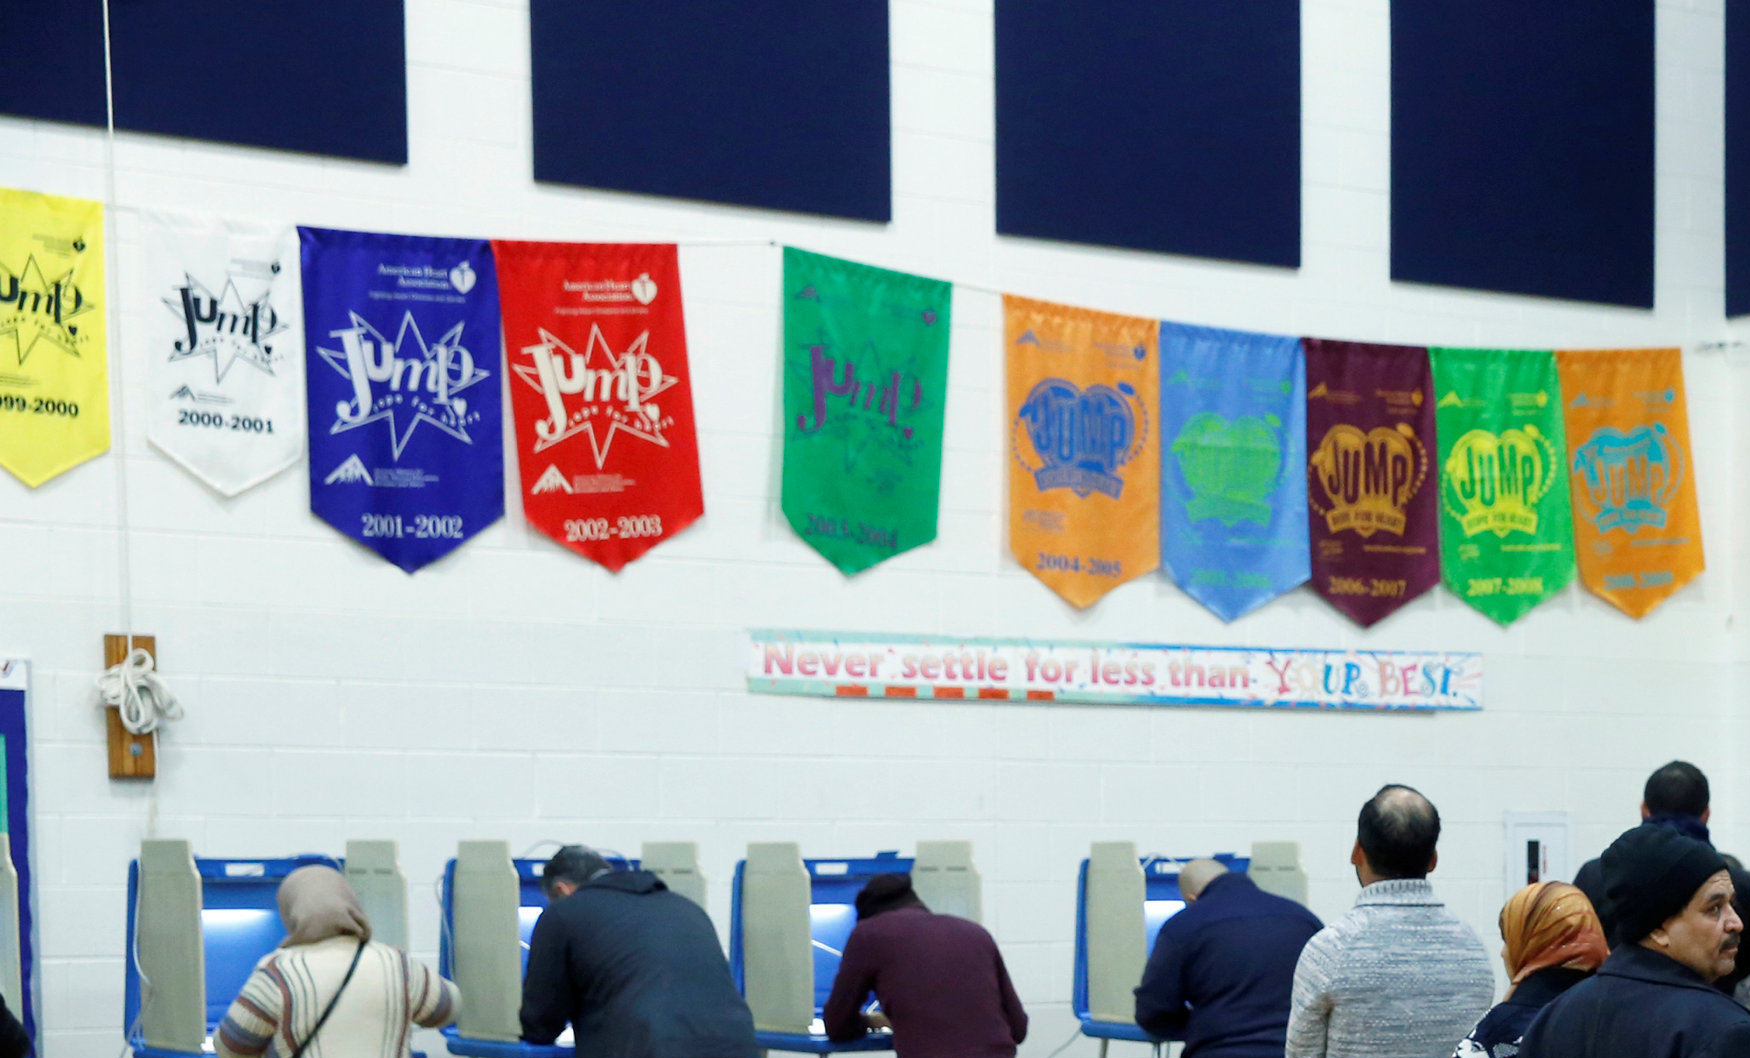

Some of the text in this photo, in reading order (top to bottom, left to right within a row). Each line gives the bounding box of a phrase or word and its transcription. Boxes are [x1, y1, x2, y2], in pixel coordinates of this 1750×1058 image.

[0, 275, 82, 324] ump
[329, 327, 474, 422] Jump
[521, 342, 663, 441] Jump
[0, 394, 79, 417] 99-2000
[178, 411, 274, 433] 2000-2001
[1327, 438, 1407, 508] JUMP
[1460, 443, 1533, 507] JUMP
[361, 512, 463, 538] 2001-2002
[564, 514, 662, 542] 2002-2003
[764, 644, 884, 678] Never
[902, 651, 1008, 682] settle
[1026, 652, 1079, 684] for
[1091, 650, 1156, 687] less
[1167, 660, 1249, 689] than
